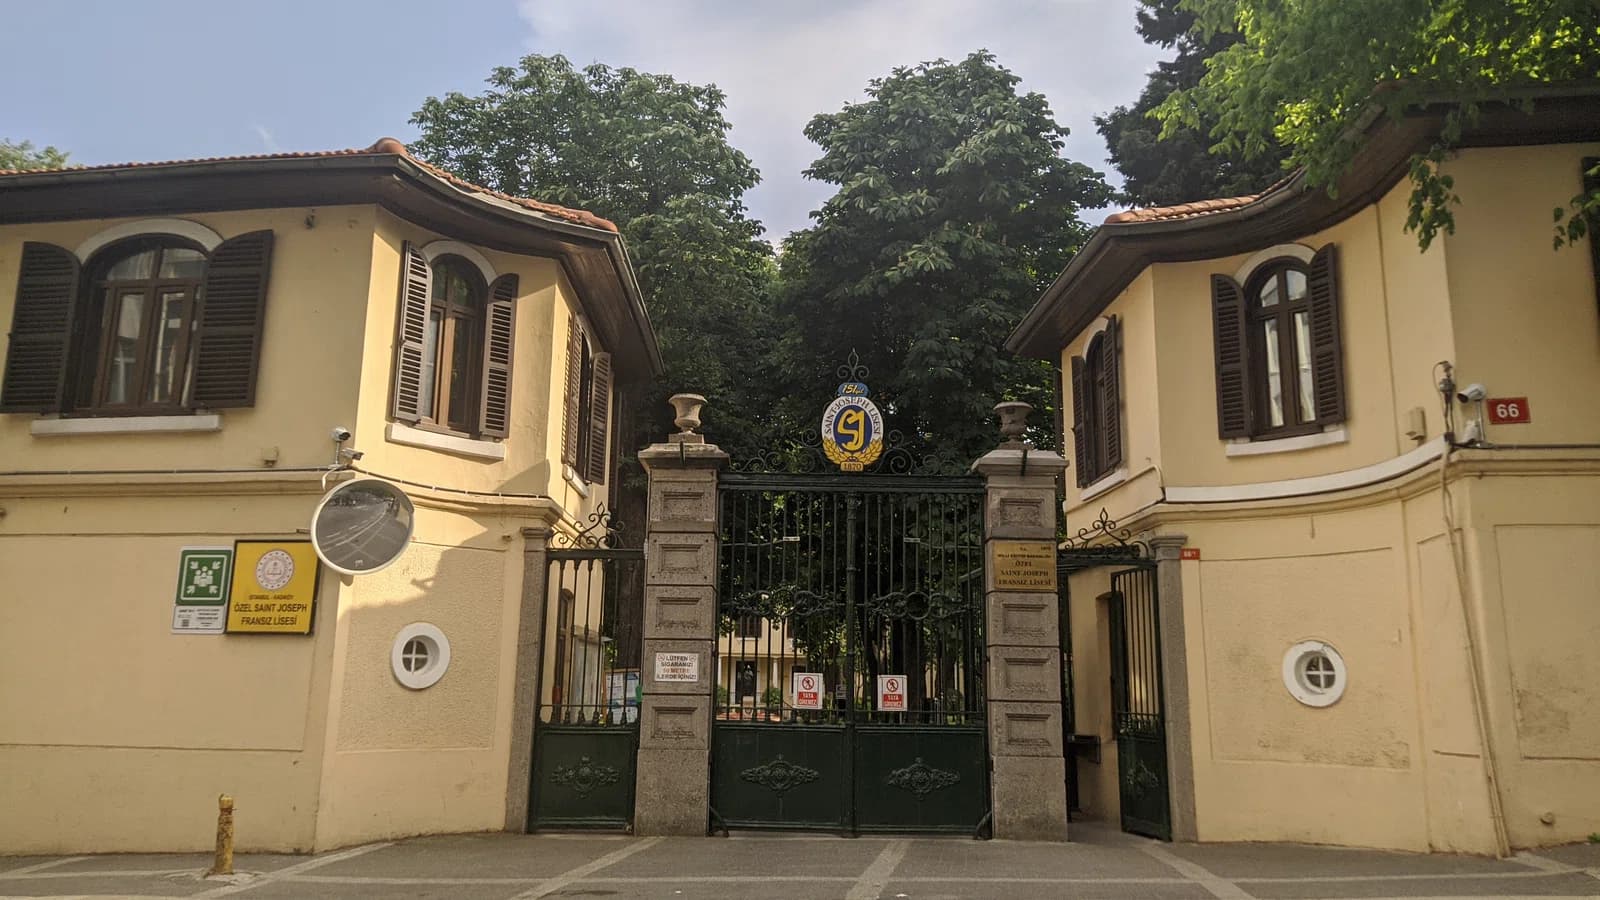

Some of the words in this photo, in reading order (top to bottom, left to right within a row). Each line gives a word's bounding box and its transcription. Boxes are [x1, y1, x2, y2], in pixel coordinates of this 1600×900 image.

[1496, 403, 1520, 418] 66
[843, 462, 862, 470] 1870
[1015, 559, 1032, 567] ÖZEL
[234, 601, 253, 612] ÖZEL
[254, 603, 276, 612] SAINT
[276, 603, 308, 612] JOSEPH
[241, 616, 273, 625] FRANSIZ
[274, 615, 297, 625] LİSESİ
